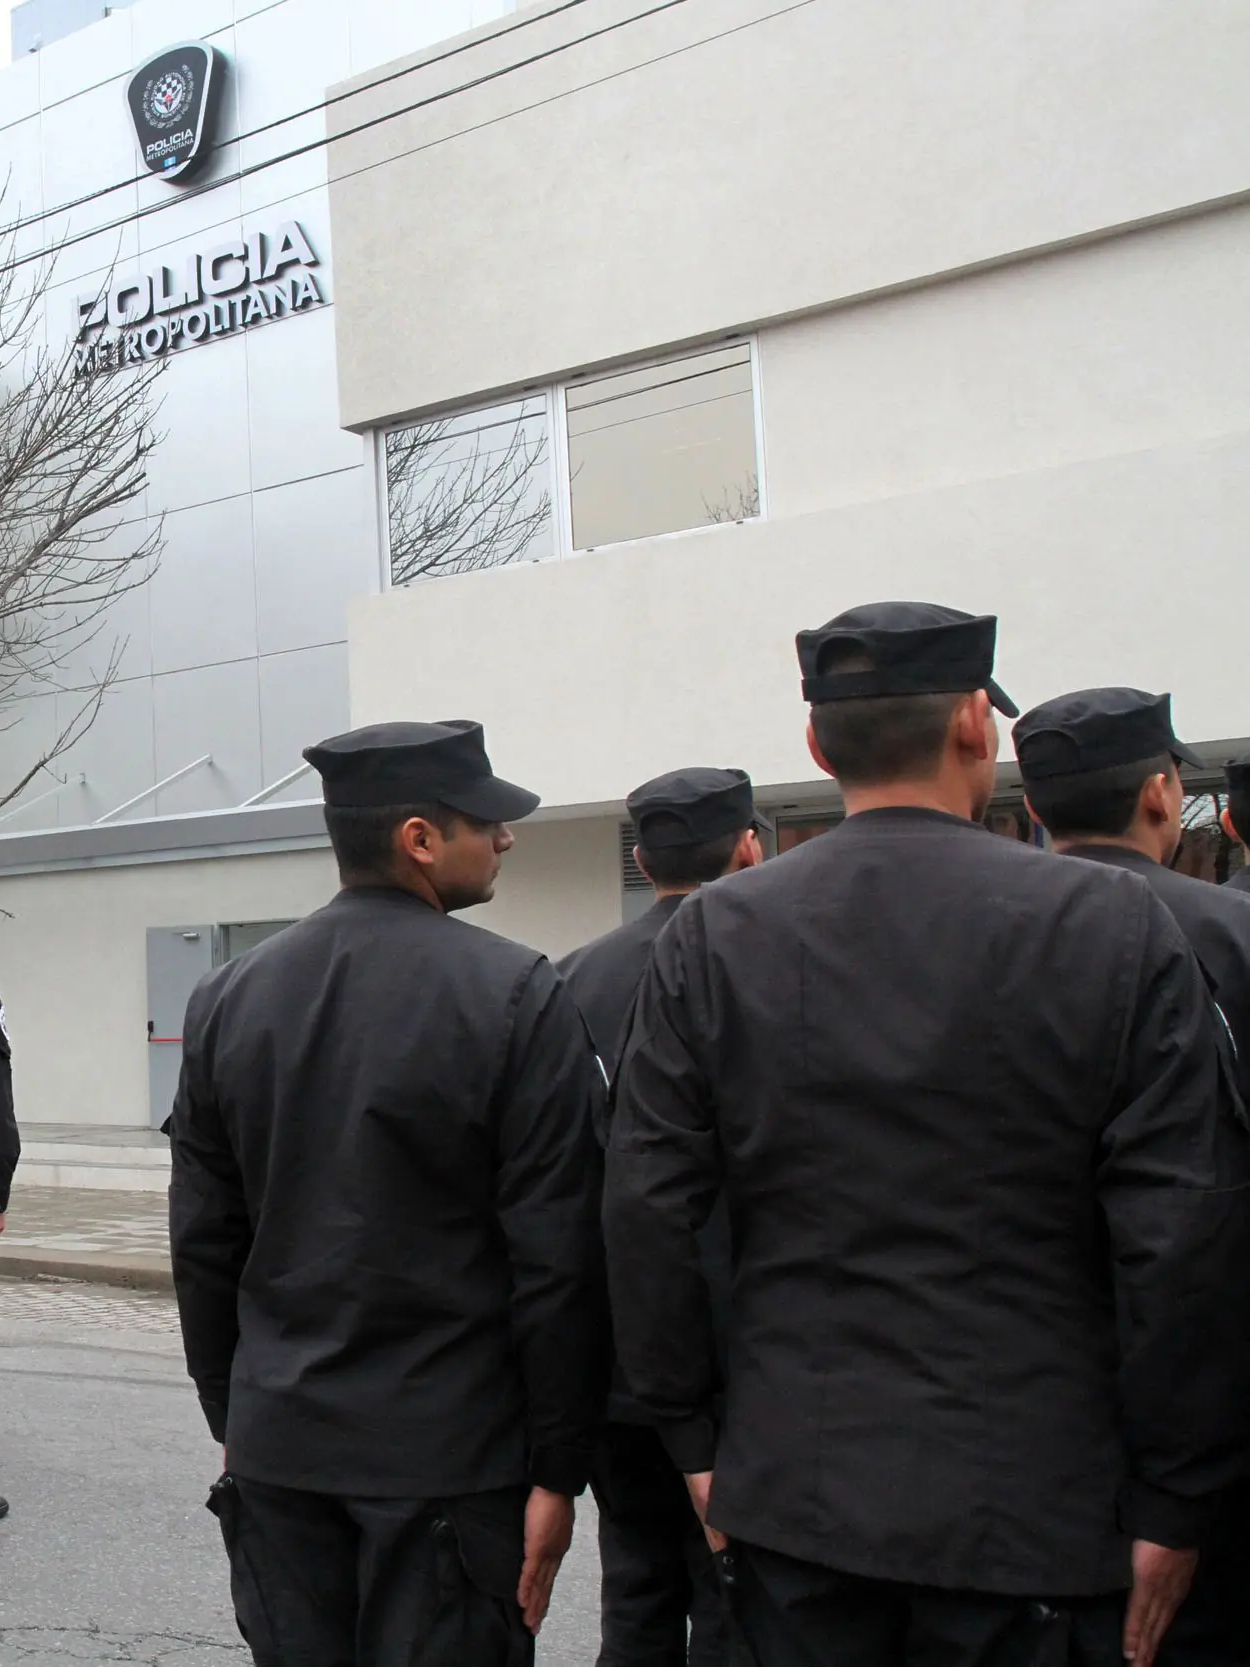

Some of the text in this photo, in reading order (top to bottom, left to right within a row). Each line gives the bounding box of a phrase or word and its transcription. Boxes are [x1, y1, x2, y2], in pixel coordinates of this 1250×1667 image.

[146, 128, 194, 155] POLICIA
[146, 137, 194, 162] METROPOLITANA
[71, 219, 319, 341] POLICIA
[71, 272, 323, 376] METROPOLITANA
